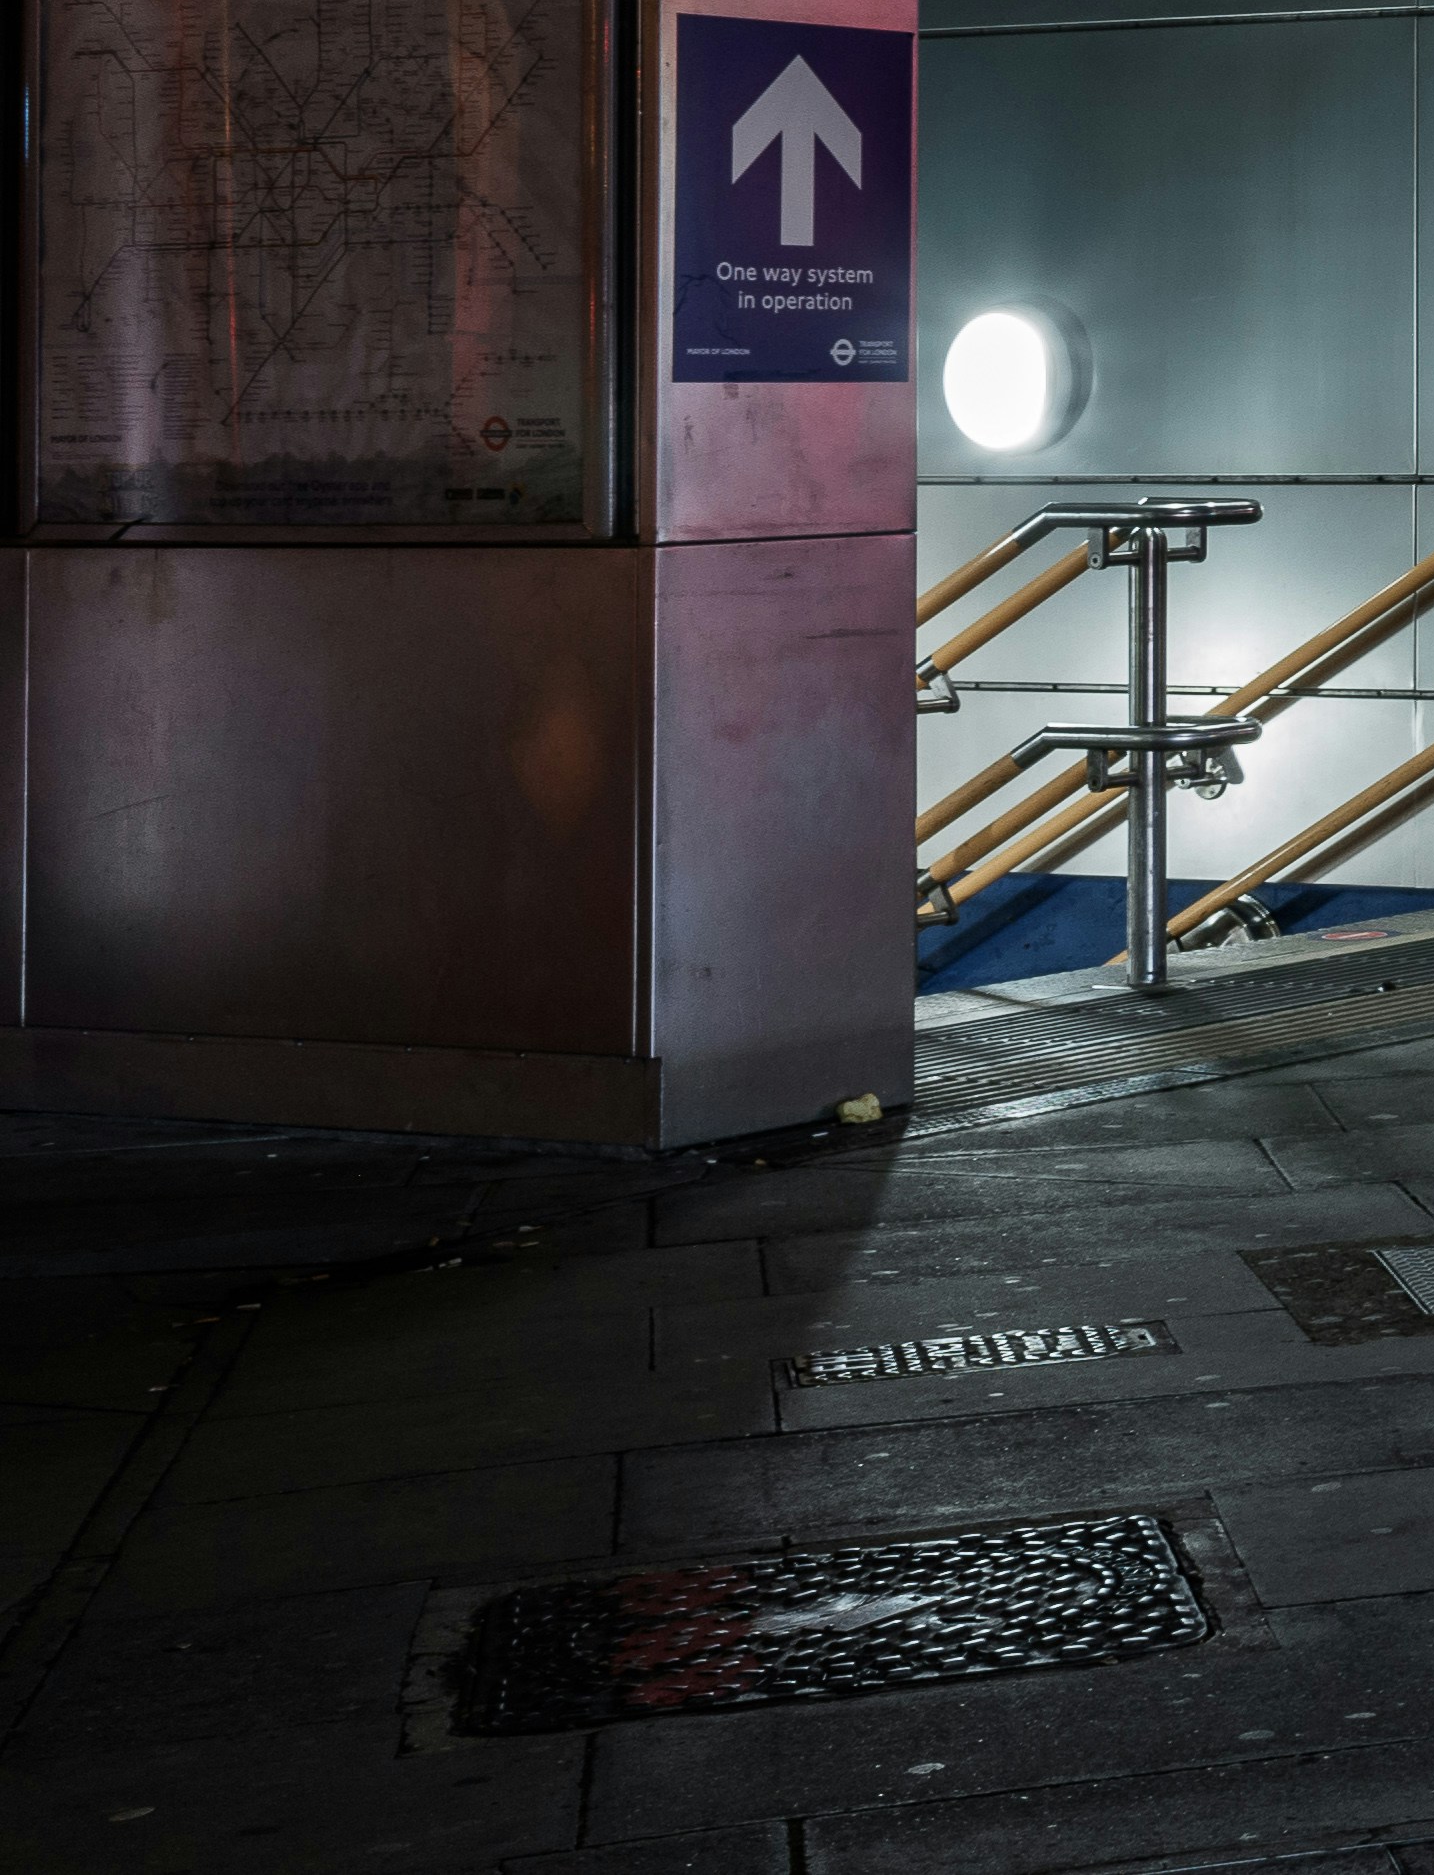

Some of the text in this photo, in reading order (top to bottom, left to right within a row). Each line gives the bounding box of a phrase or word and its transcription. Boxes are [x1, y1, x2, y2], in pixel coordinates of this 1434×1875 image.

[716, 261, 874, 286] One way system
[738, 291, 853, 313] in operation
